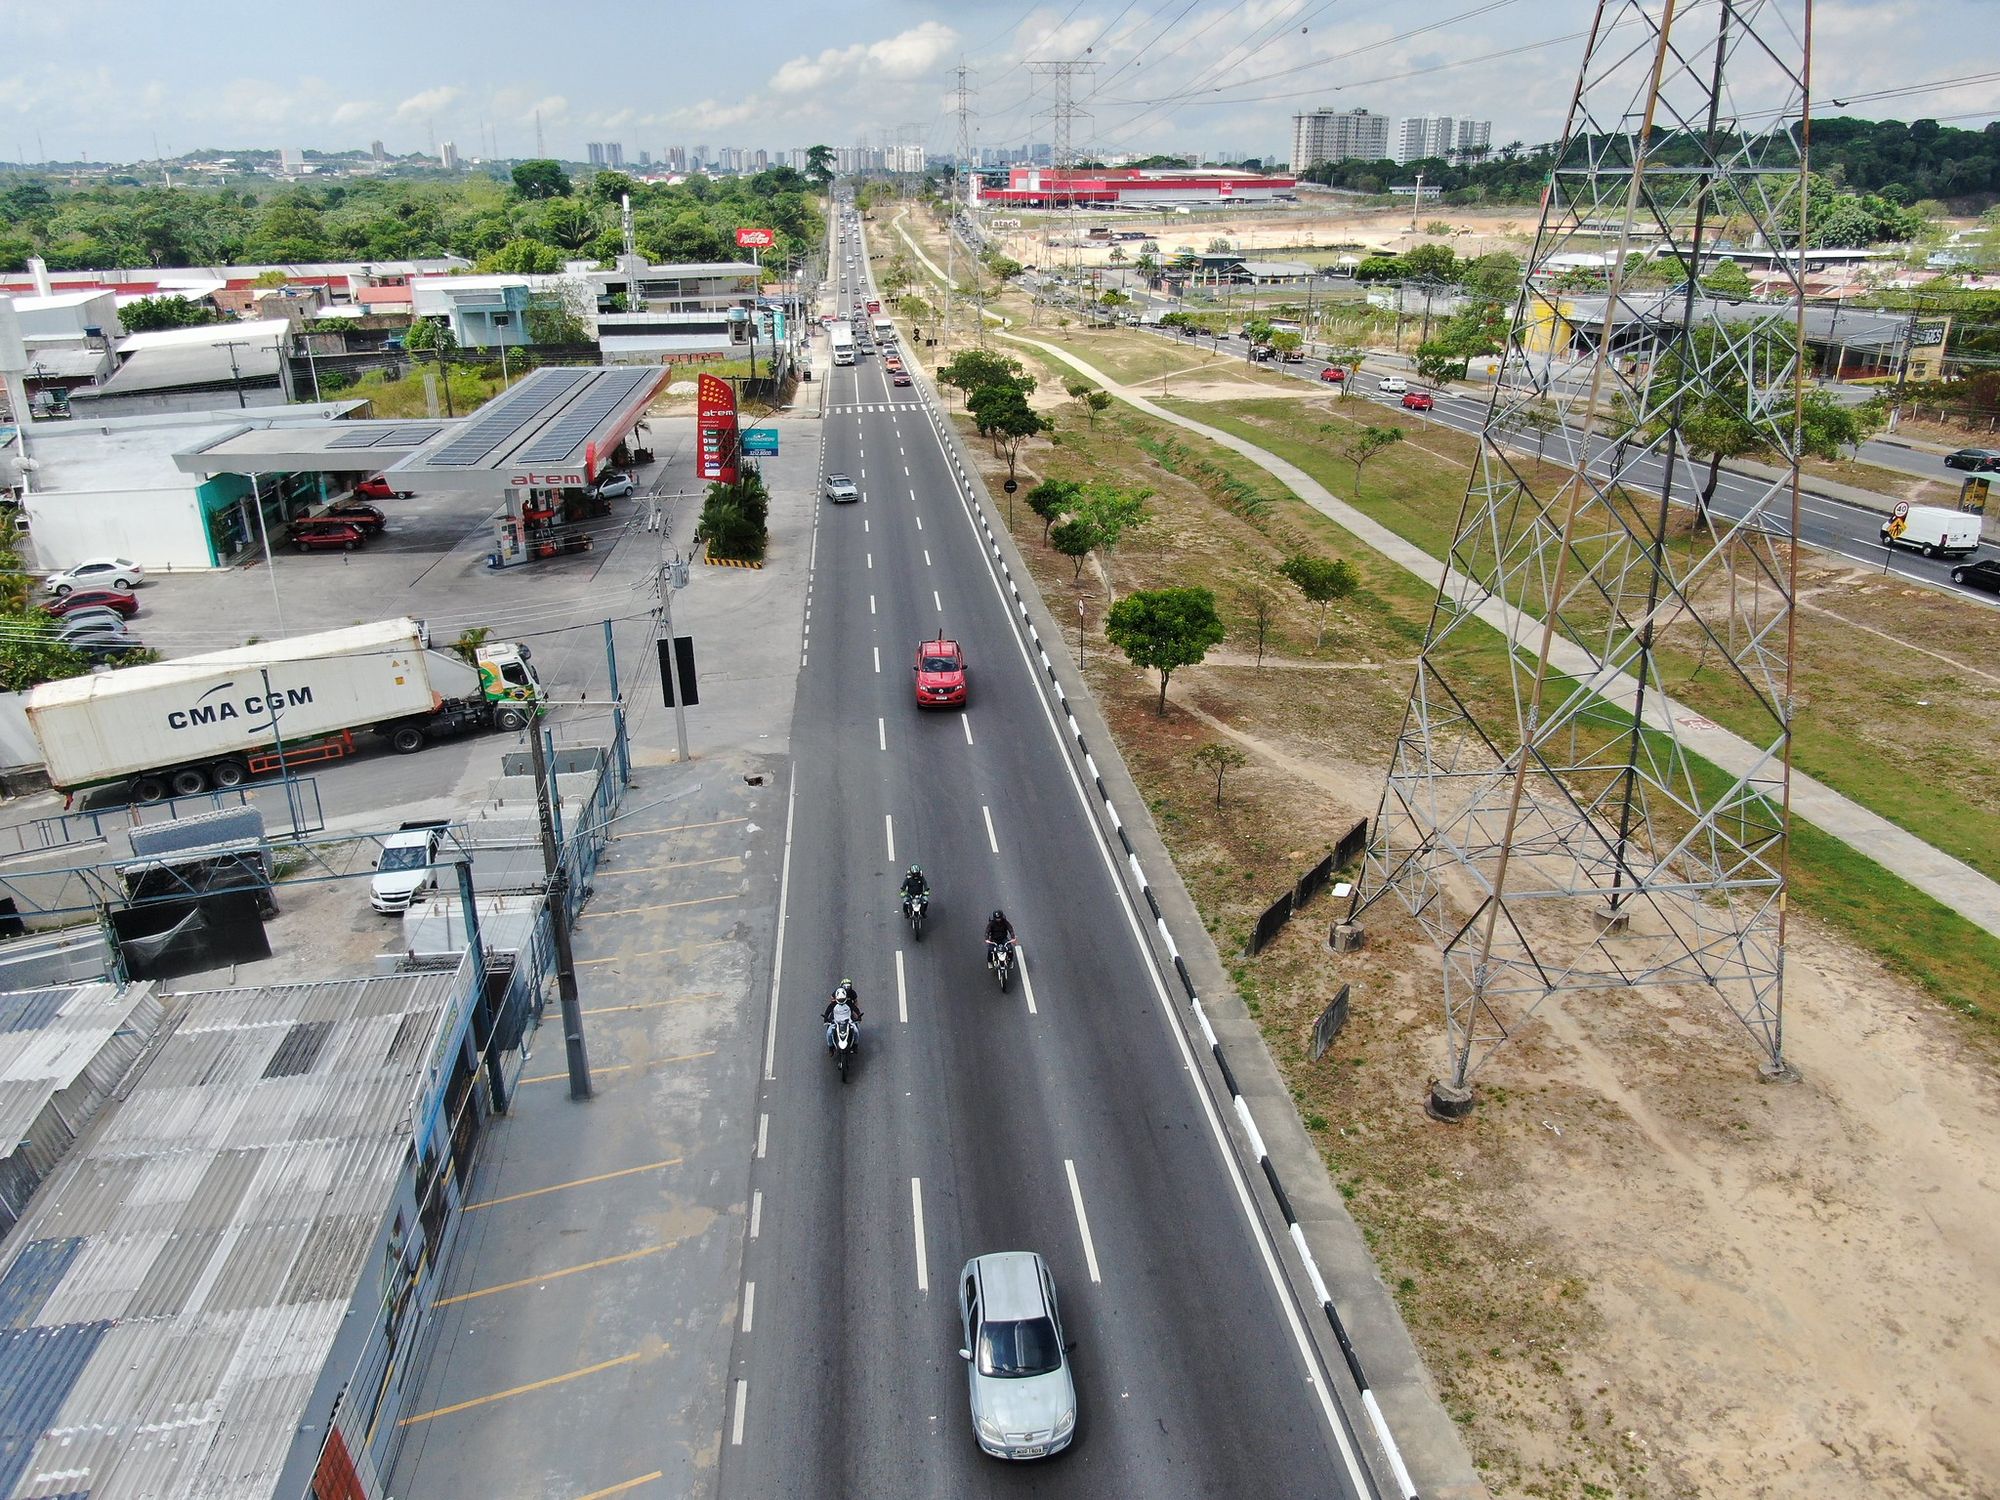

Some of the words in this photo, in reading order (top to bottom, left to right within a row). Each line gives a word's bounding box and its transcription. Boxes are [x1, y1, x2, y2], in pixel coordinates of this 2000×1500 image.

[702, 409, 734, 417] atem
[511, 472, 582, 486] atem
[167, 702, 239, 730] CMA
[244, 686, 314, 715] CGM
